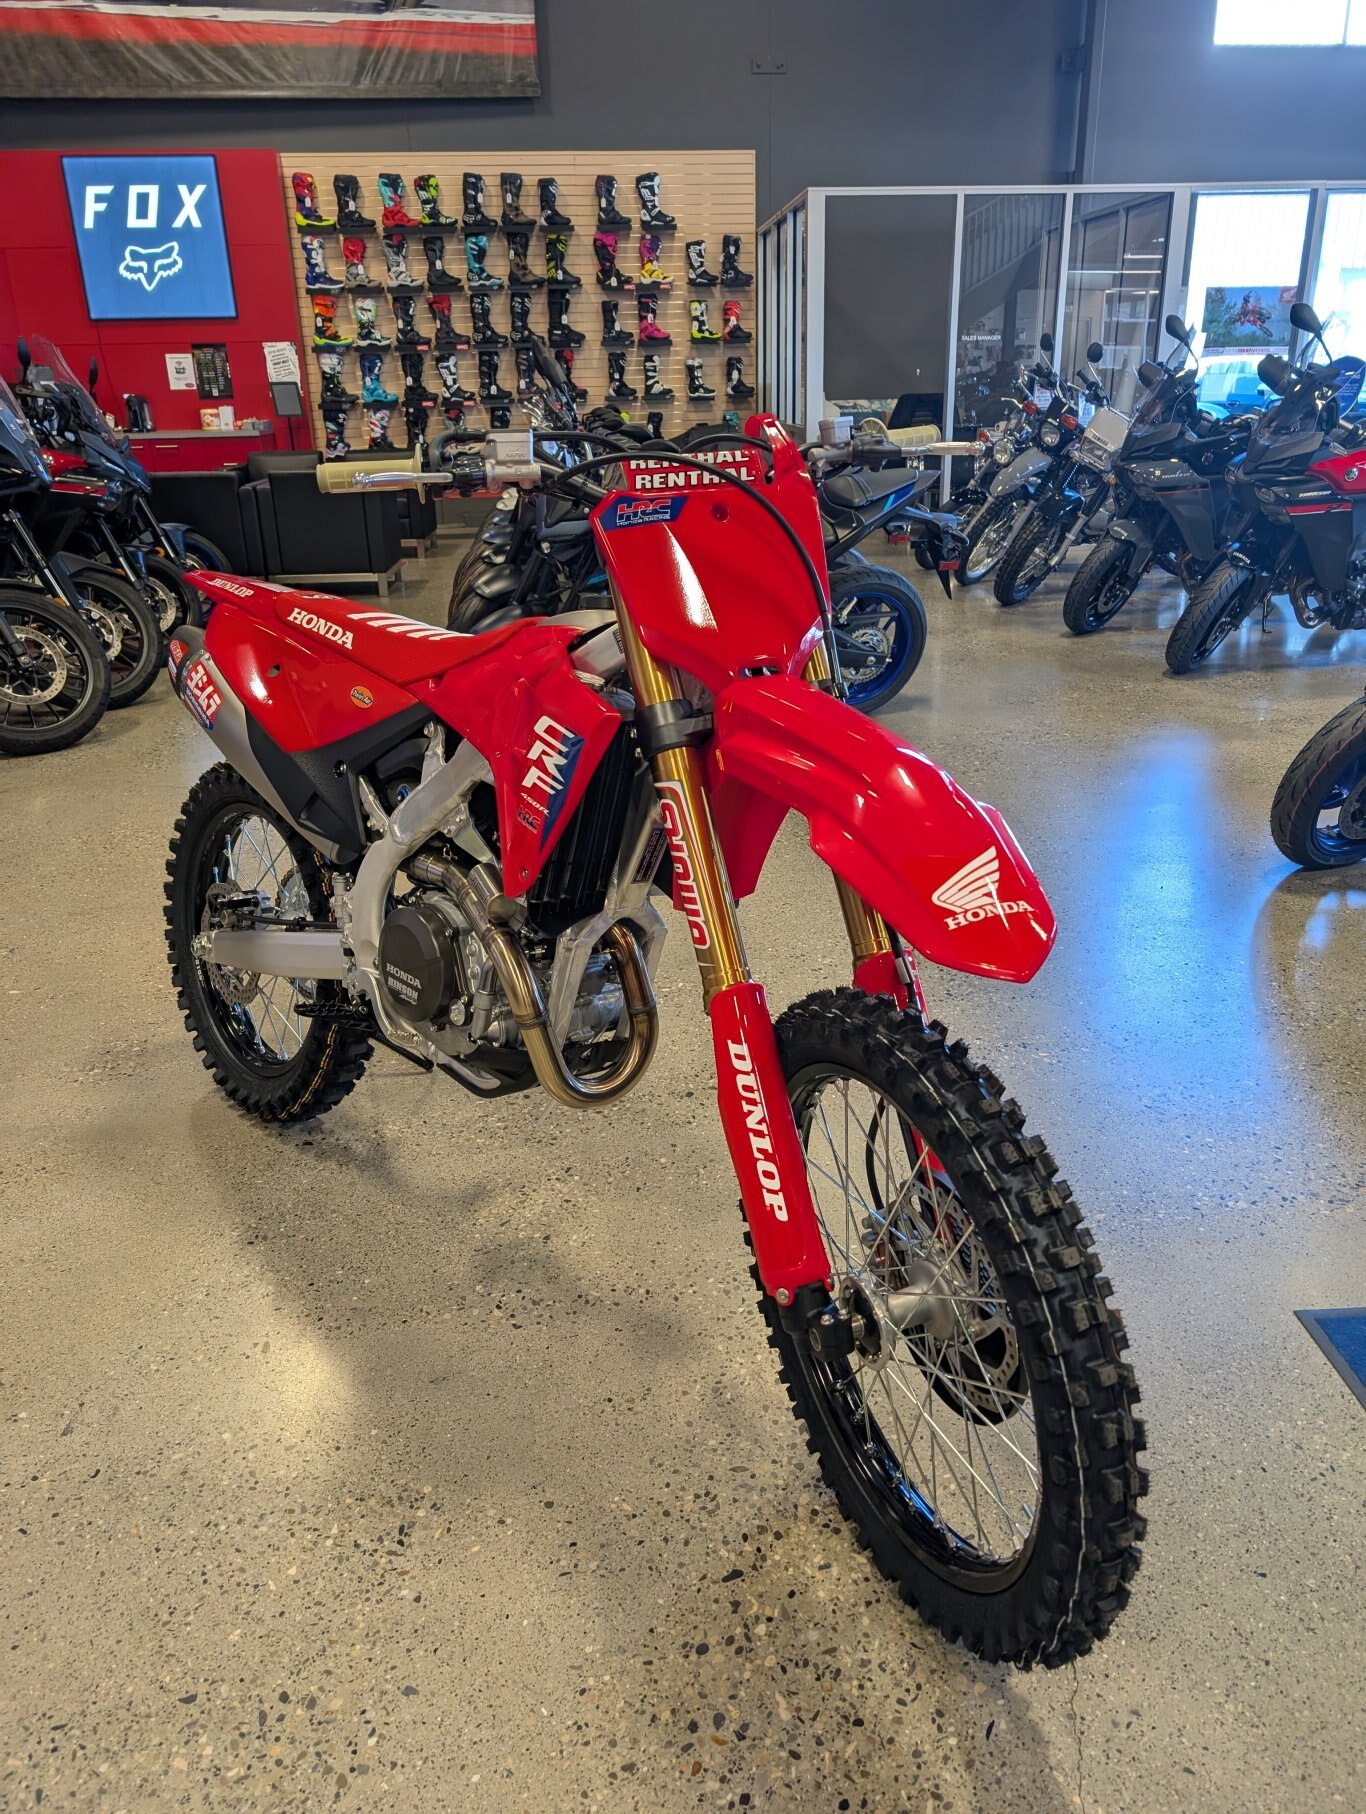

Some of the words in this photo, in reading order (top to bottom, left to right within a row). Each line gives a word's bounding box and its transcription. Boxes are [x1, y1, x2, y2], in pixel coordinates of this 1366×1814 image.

[84, 184, 207, 229] FOX
[630, 450, 750, 470] REHAL
[616, 499, 671, 523] HRC
[208, 578, 255, 598] DUNLOP
[287, 607, 353, 650] HONDA
[521, 715, 576, 795] CRF
[520, 792, 550, 817] 450R
[943, 900, 1036, 931] HONDA
[386, 962, 422, 989] HONDA
[726, 1039, 789, 1222] DUNLOP
